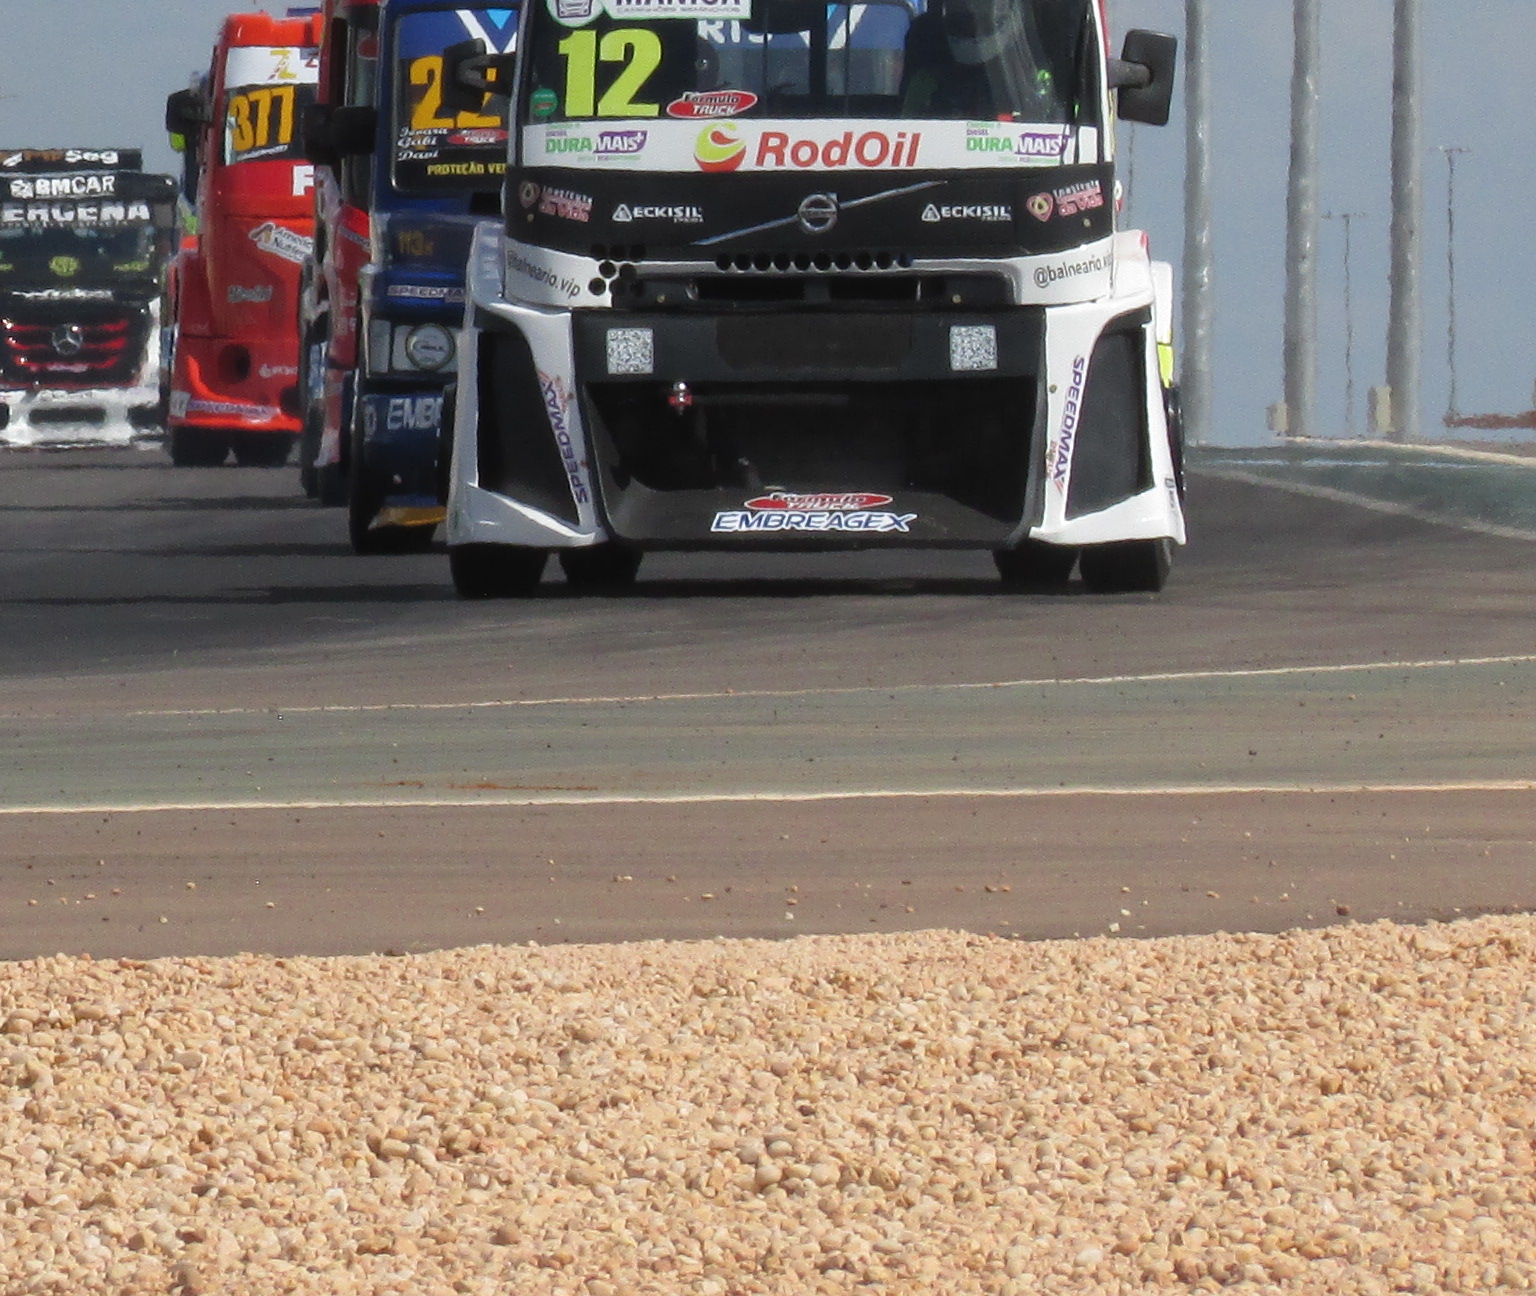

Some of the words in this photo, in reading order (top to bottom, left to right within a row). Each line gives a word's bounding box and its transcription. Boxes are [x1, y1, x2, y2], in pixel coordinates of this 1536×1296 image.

[559, 28, 664, 117] 12
[692, 104, 737, 115] TRUCK
[545, 137, 592, 153] DURA
[755, 130, 922, 168] RodOil
[966, 137, 1014, 152] DURA
[632, 206, 702, 218] ECKISIL
[940, 205, 1011, 218] ECKISIL
[1054, 354, 1086, 480] SPEEDMAX
[711, 511, 918, 533] EMBREAGEX
